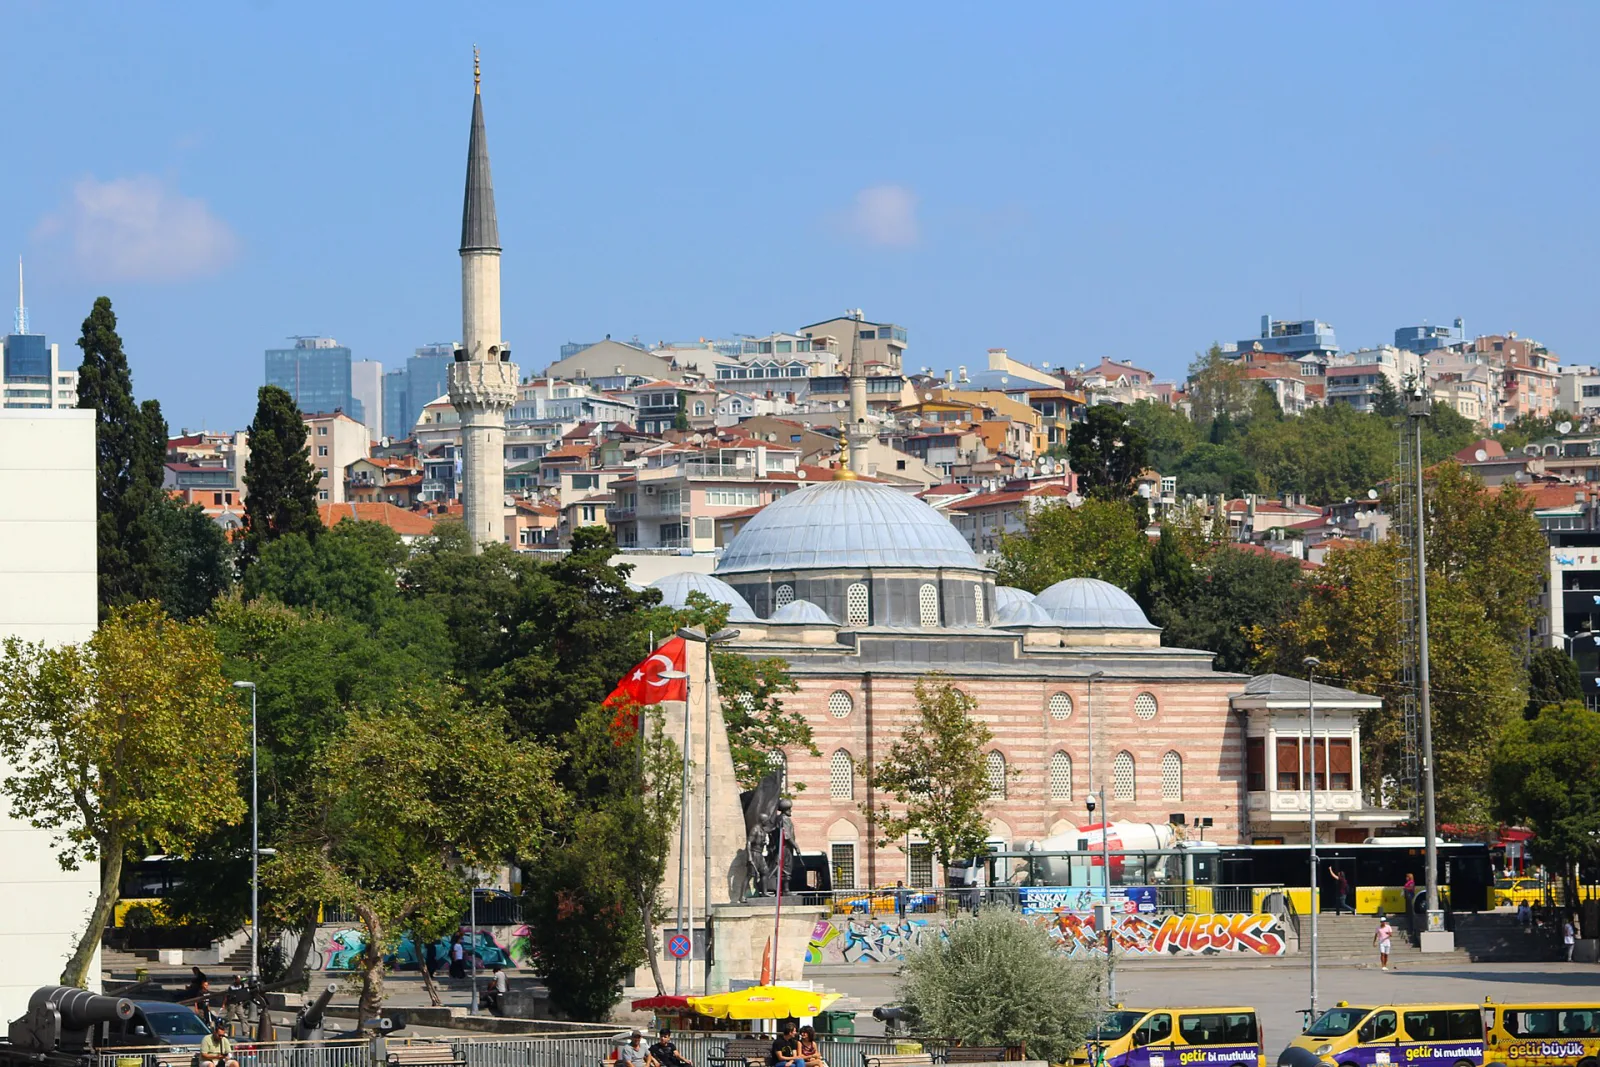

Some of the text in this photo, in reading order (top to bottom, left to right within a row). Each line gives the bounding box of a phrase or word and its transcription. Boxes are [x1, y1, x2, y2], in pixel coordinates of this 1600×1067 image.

[1027, 893, 1066, 901] KAYKAY
[1153, 913, 1284, 955] MECK
[1180, 1049, 1257, 1065] getir bi mutluluk
[1406, 1046, 1482, 1061] getir bi mutluluk
